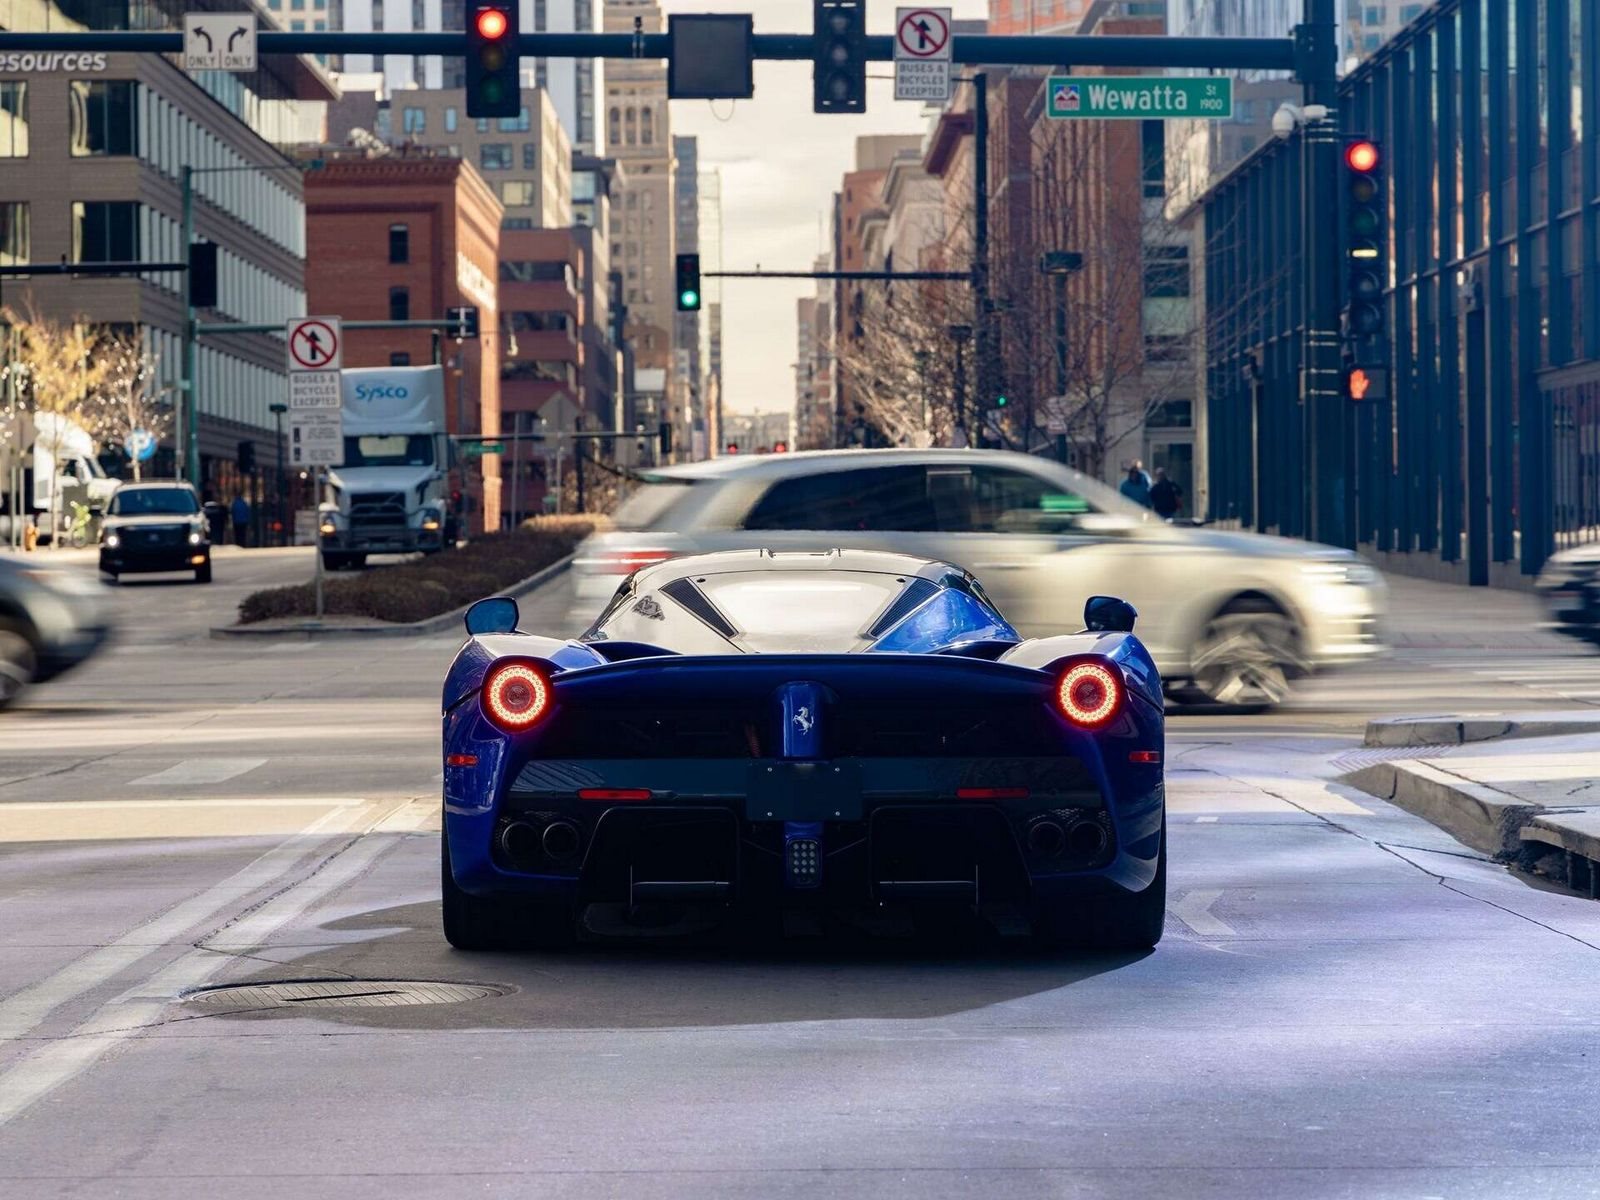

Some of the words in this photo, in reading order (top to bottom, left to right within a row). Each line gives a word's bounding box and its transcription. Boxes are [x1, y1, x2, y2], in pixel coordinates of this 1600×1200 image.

[189, 56, 215, 67] ONLY
[225, 56, 251, 67] ONLY
[900, 63, 934, 72] BUSES
[937, 64, 944, 73] &
[900, 75, 944, 85] BICYCLES
[899, 87, 944, 96] EXCEPTED
[1088, 84, 1188, 110] Wewatta
[1205, 84, 1217, 96] St
[1200, 98, 1223, 110] 1900
[293, 374, 326, 384] BUSES
[293, 386, 336, 395] BICYCLES
[355, 385, 408, 403] Sysco
[293, 397, 336, 406] EXCEPTED
